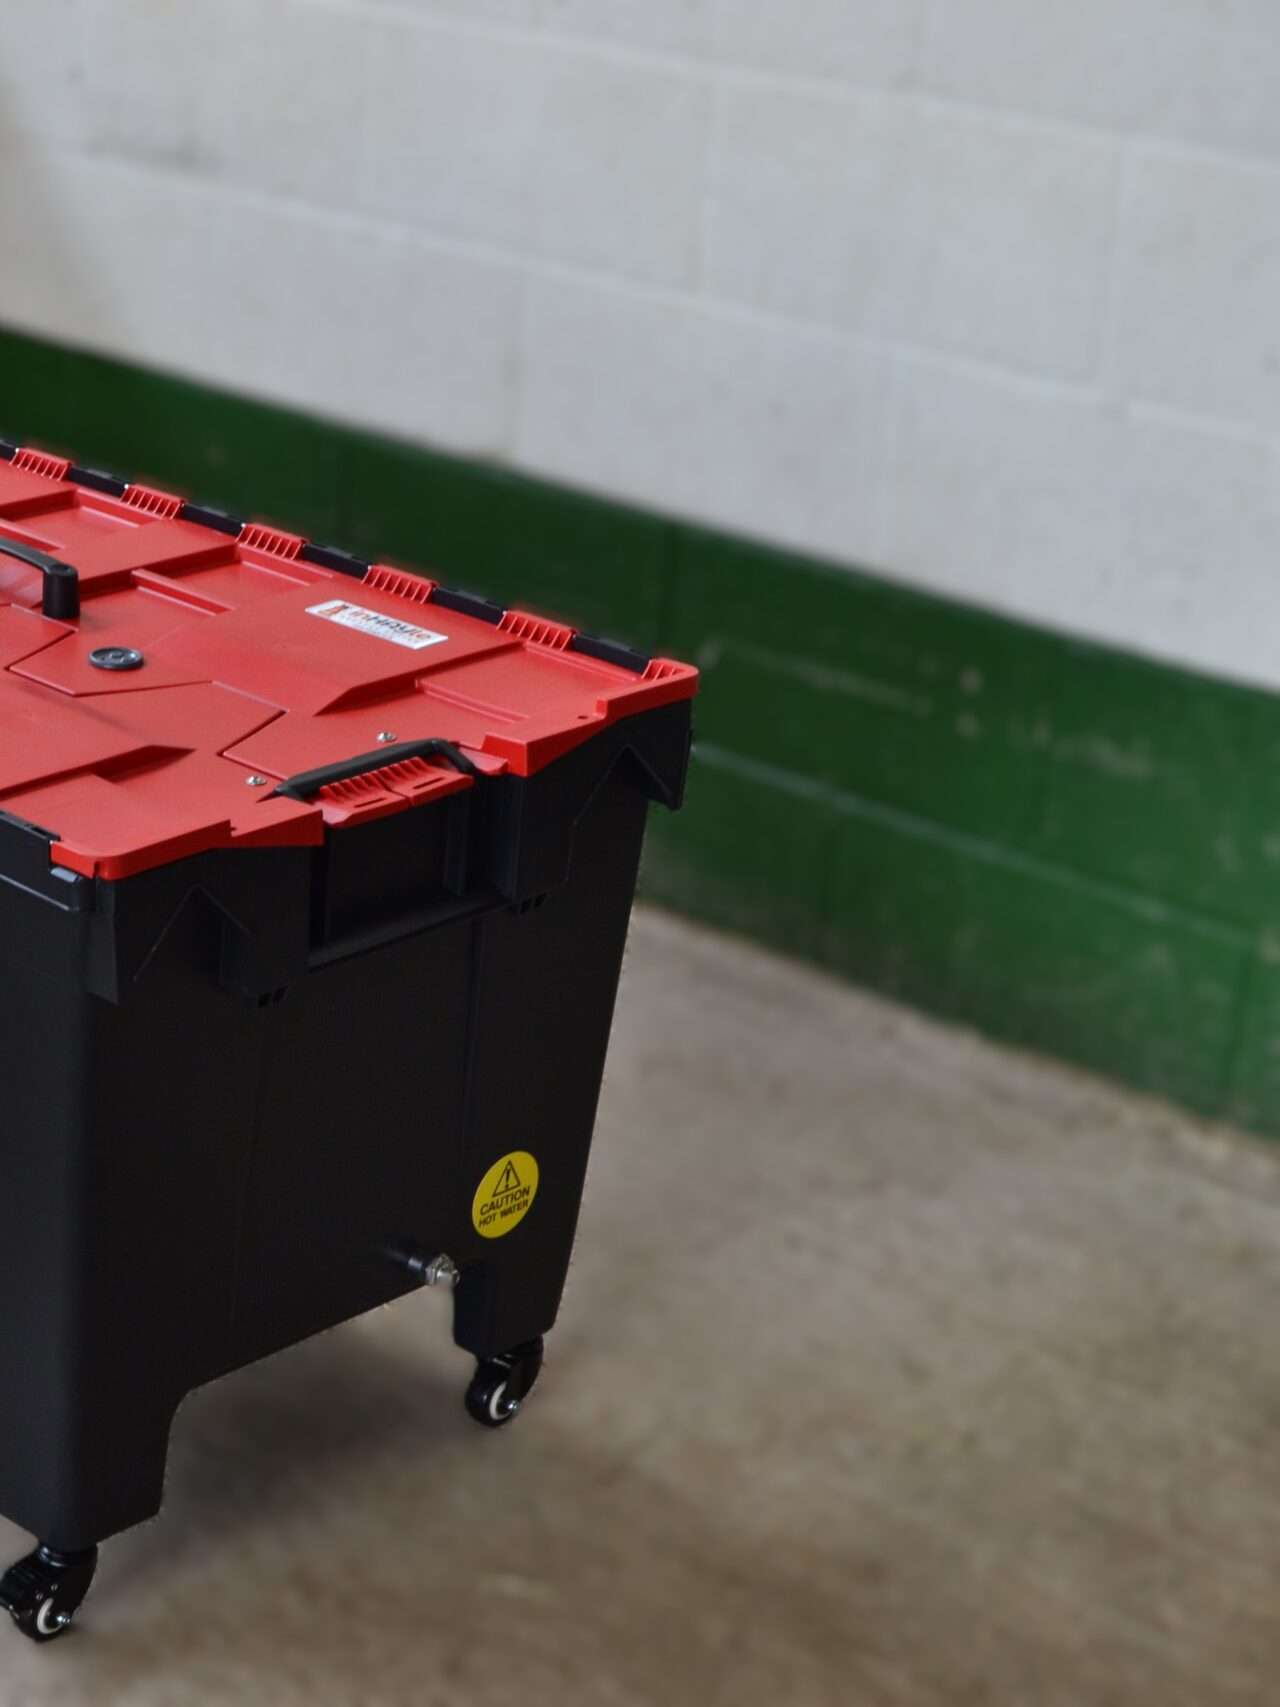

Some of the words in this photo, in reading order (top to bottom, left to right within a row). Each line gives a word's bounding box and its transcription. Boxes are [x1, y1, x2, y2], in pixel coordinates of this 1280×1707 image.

[479, 1214, 496, 1228] HOT
[500, 1199, 528, 1218] WATER
[480, 1185, 530, 1216] CAUTION
